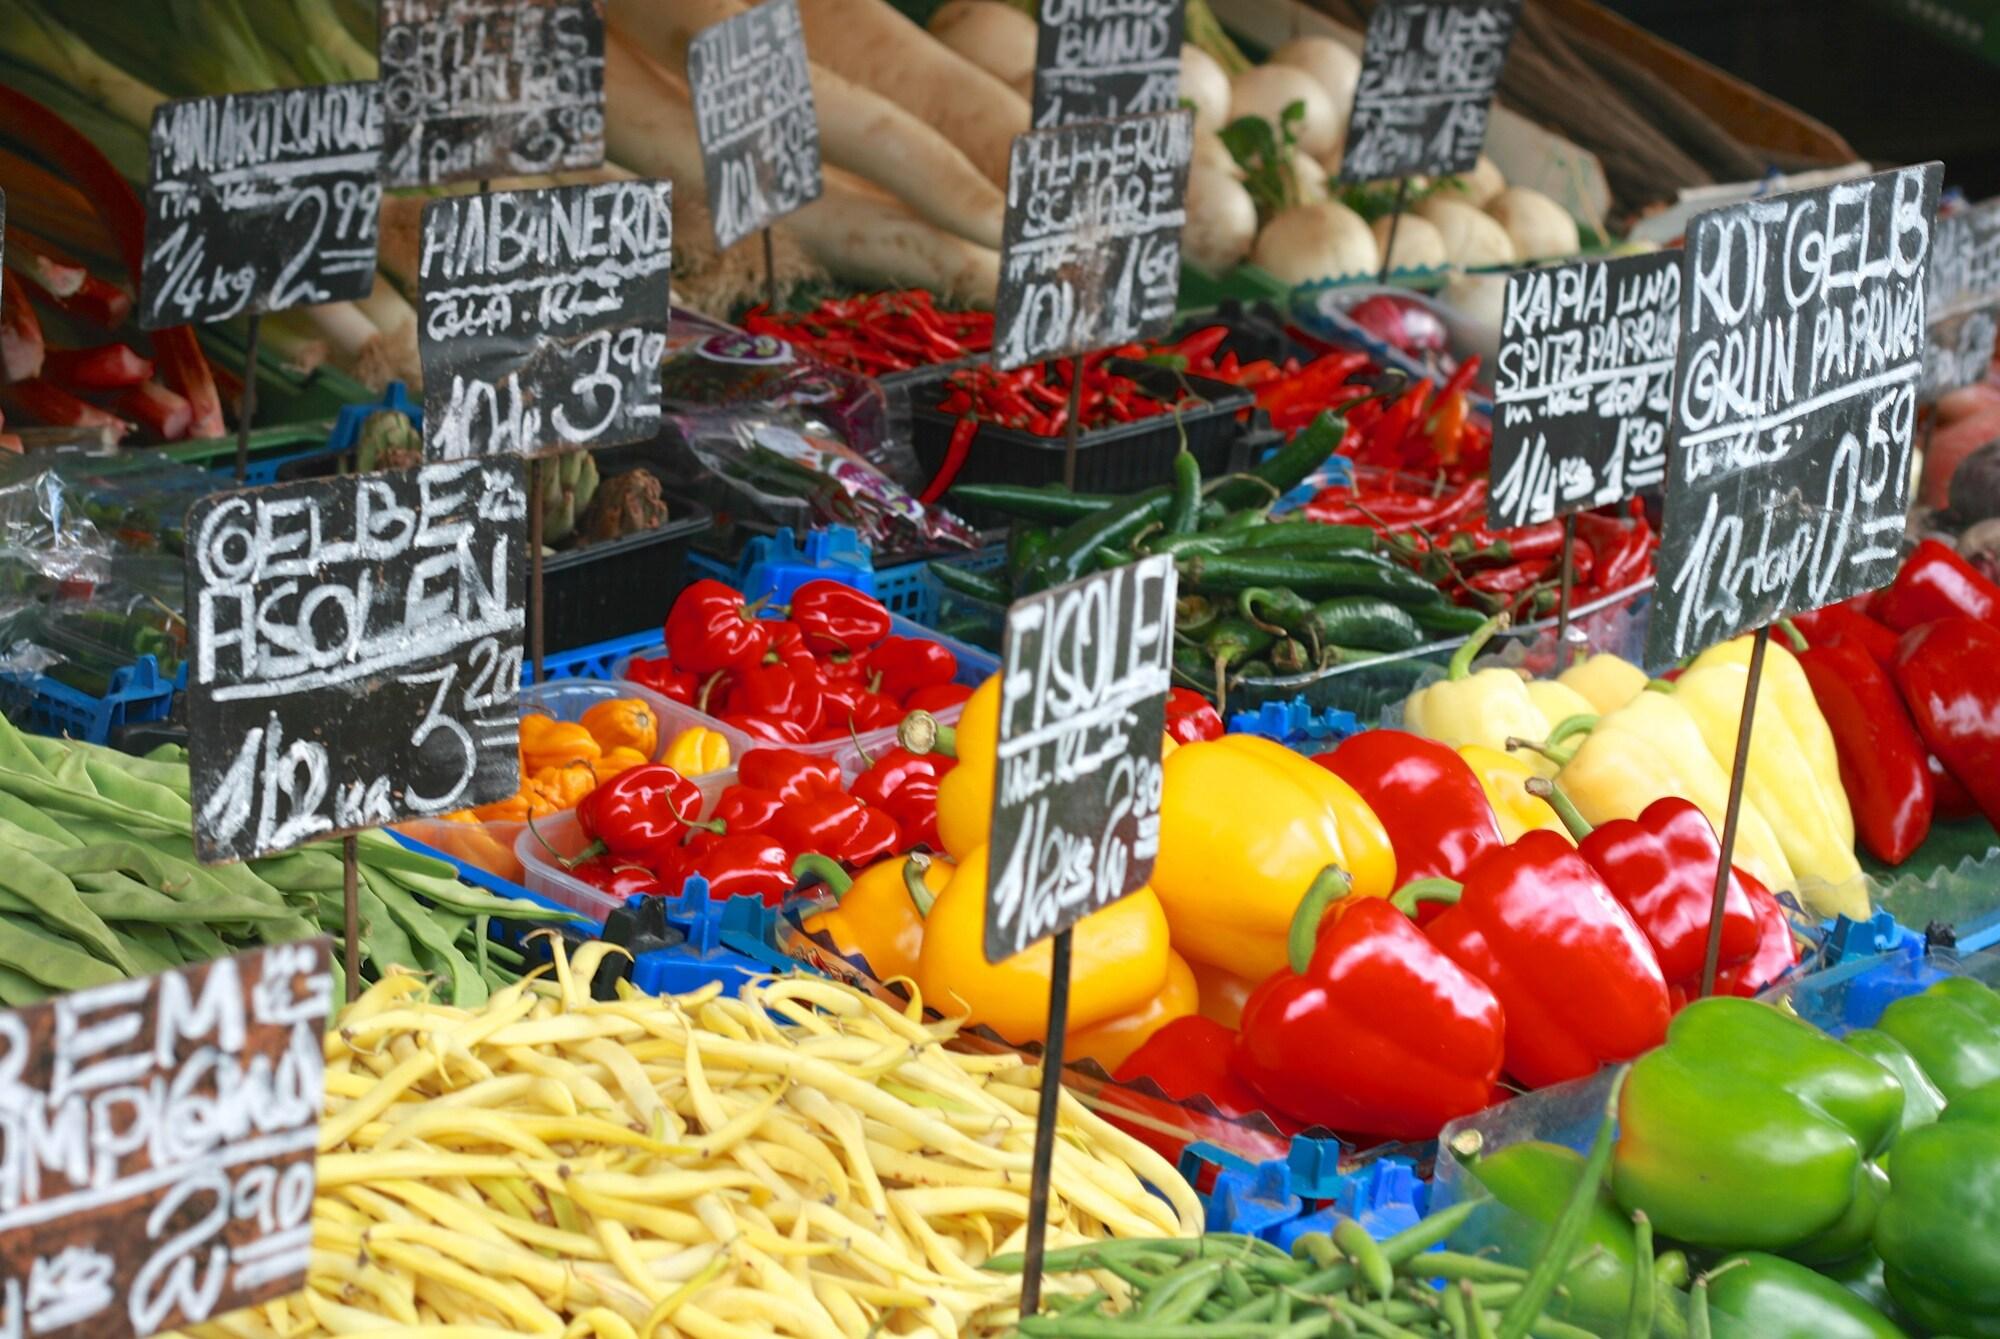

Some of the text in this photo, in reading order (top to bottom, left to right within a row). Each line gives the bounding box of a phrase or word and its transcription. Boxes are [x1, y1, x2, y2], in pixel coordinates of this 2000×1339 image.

[1055, 18, 1169, 67] BUND
[1503, 261, 1682, 338] KAPIA UND
[1690, 200, 1789, 334] ROT
[1782, 165, 1930, 309] GELB
[198, 459, 480, 587] GELBE
